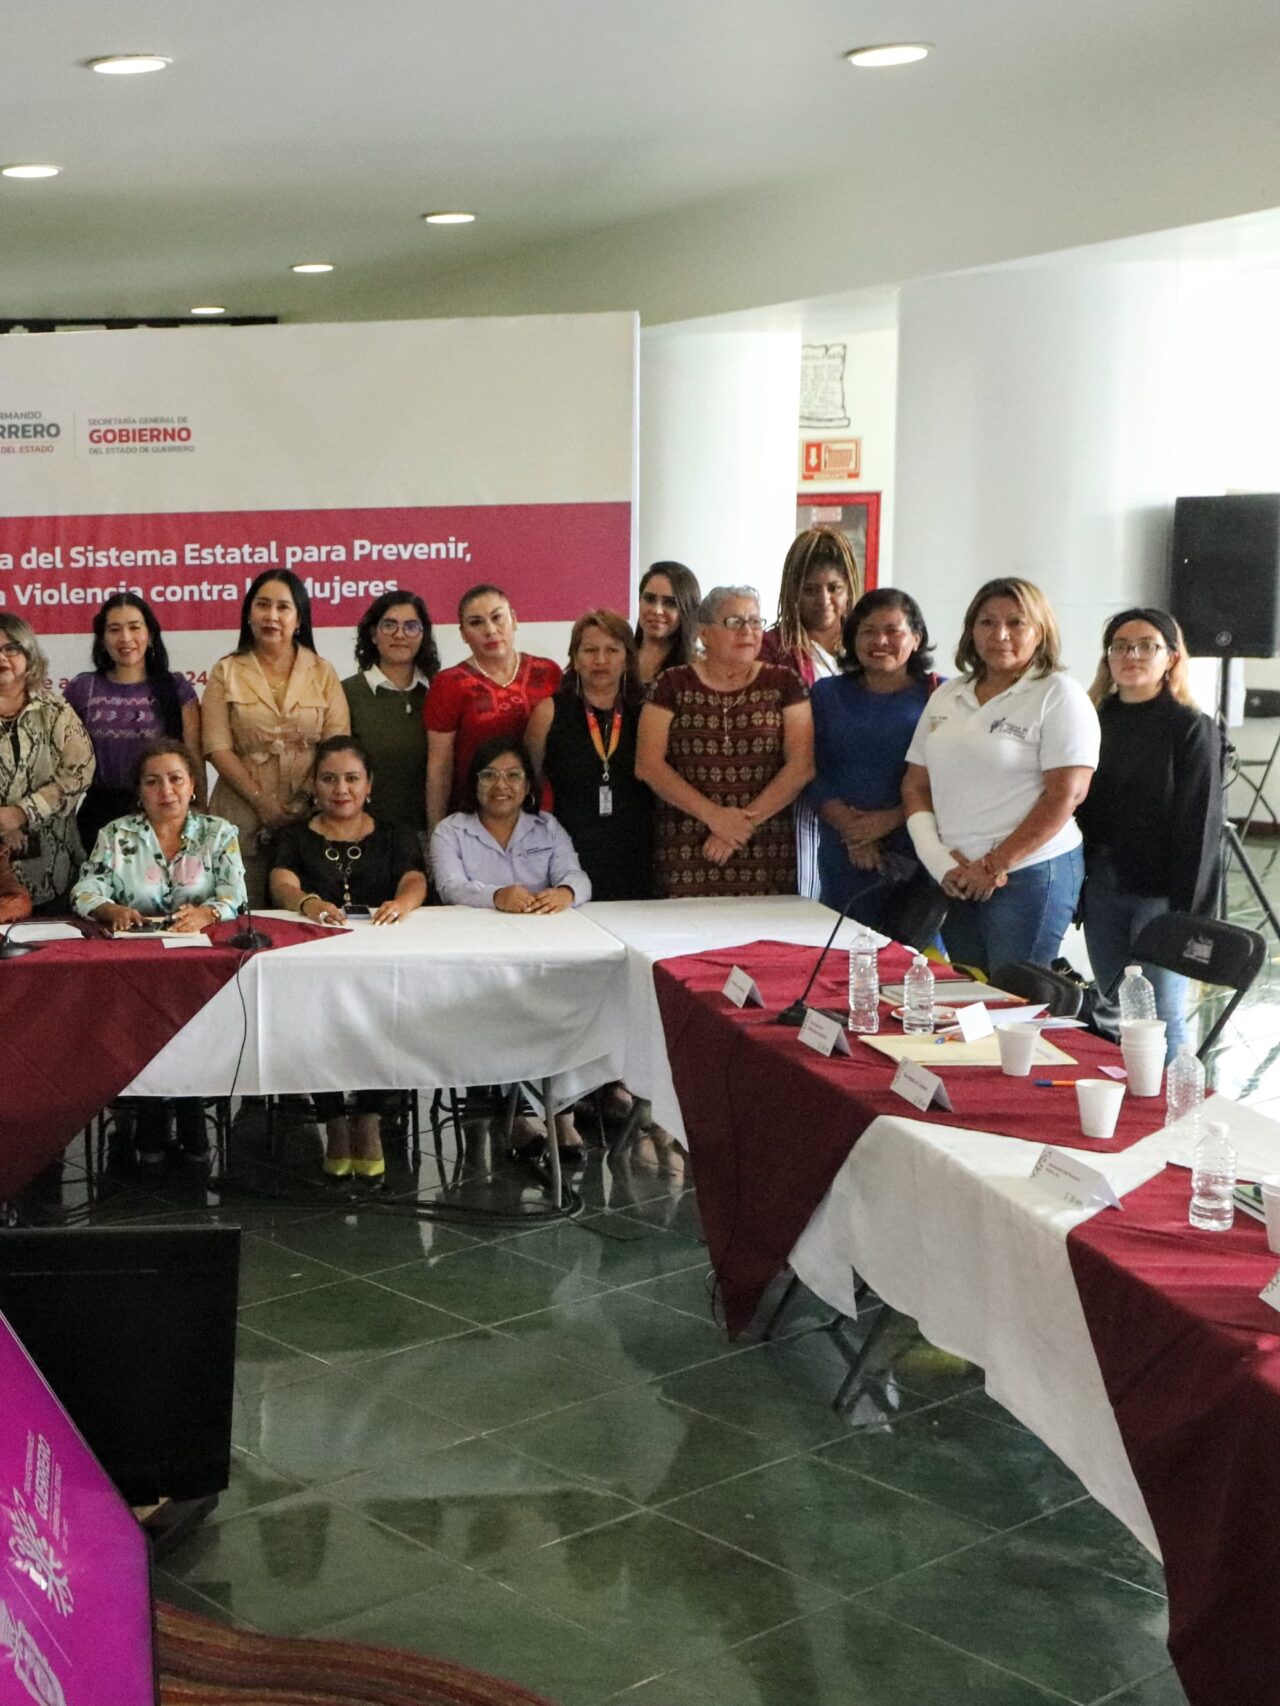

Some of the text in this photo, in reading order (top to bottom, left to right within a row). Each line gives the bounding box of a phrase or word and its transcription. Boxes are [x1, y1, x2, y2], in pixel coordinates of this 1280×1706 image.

[89, 427, 191, 443] GOBIERNO
[19, 445, 54, 453] ESTADO
[152, 445, 195, 453] GUERRERO
[21, 547, 63, 569] del
[69, 545, 178, 569] Sistema
[185, 541, 278, 565] Estatal
[286, 545, 346, 570] para
[353, 537, 472, 562] Prevenir,
[150, 579, 238, 603] contra
